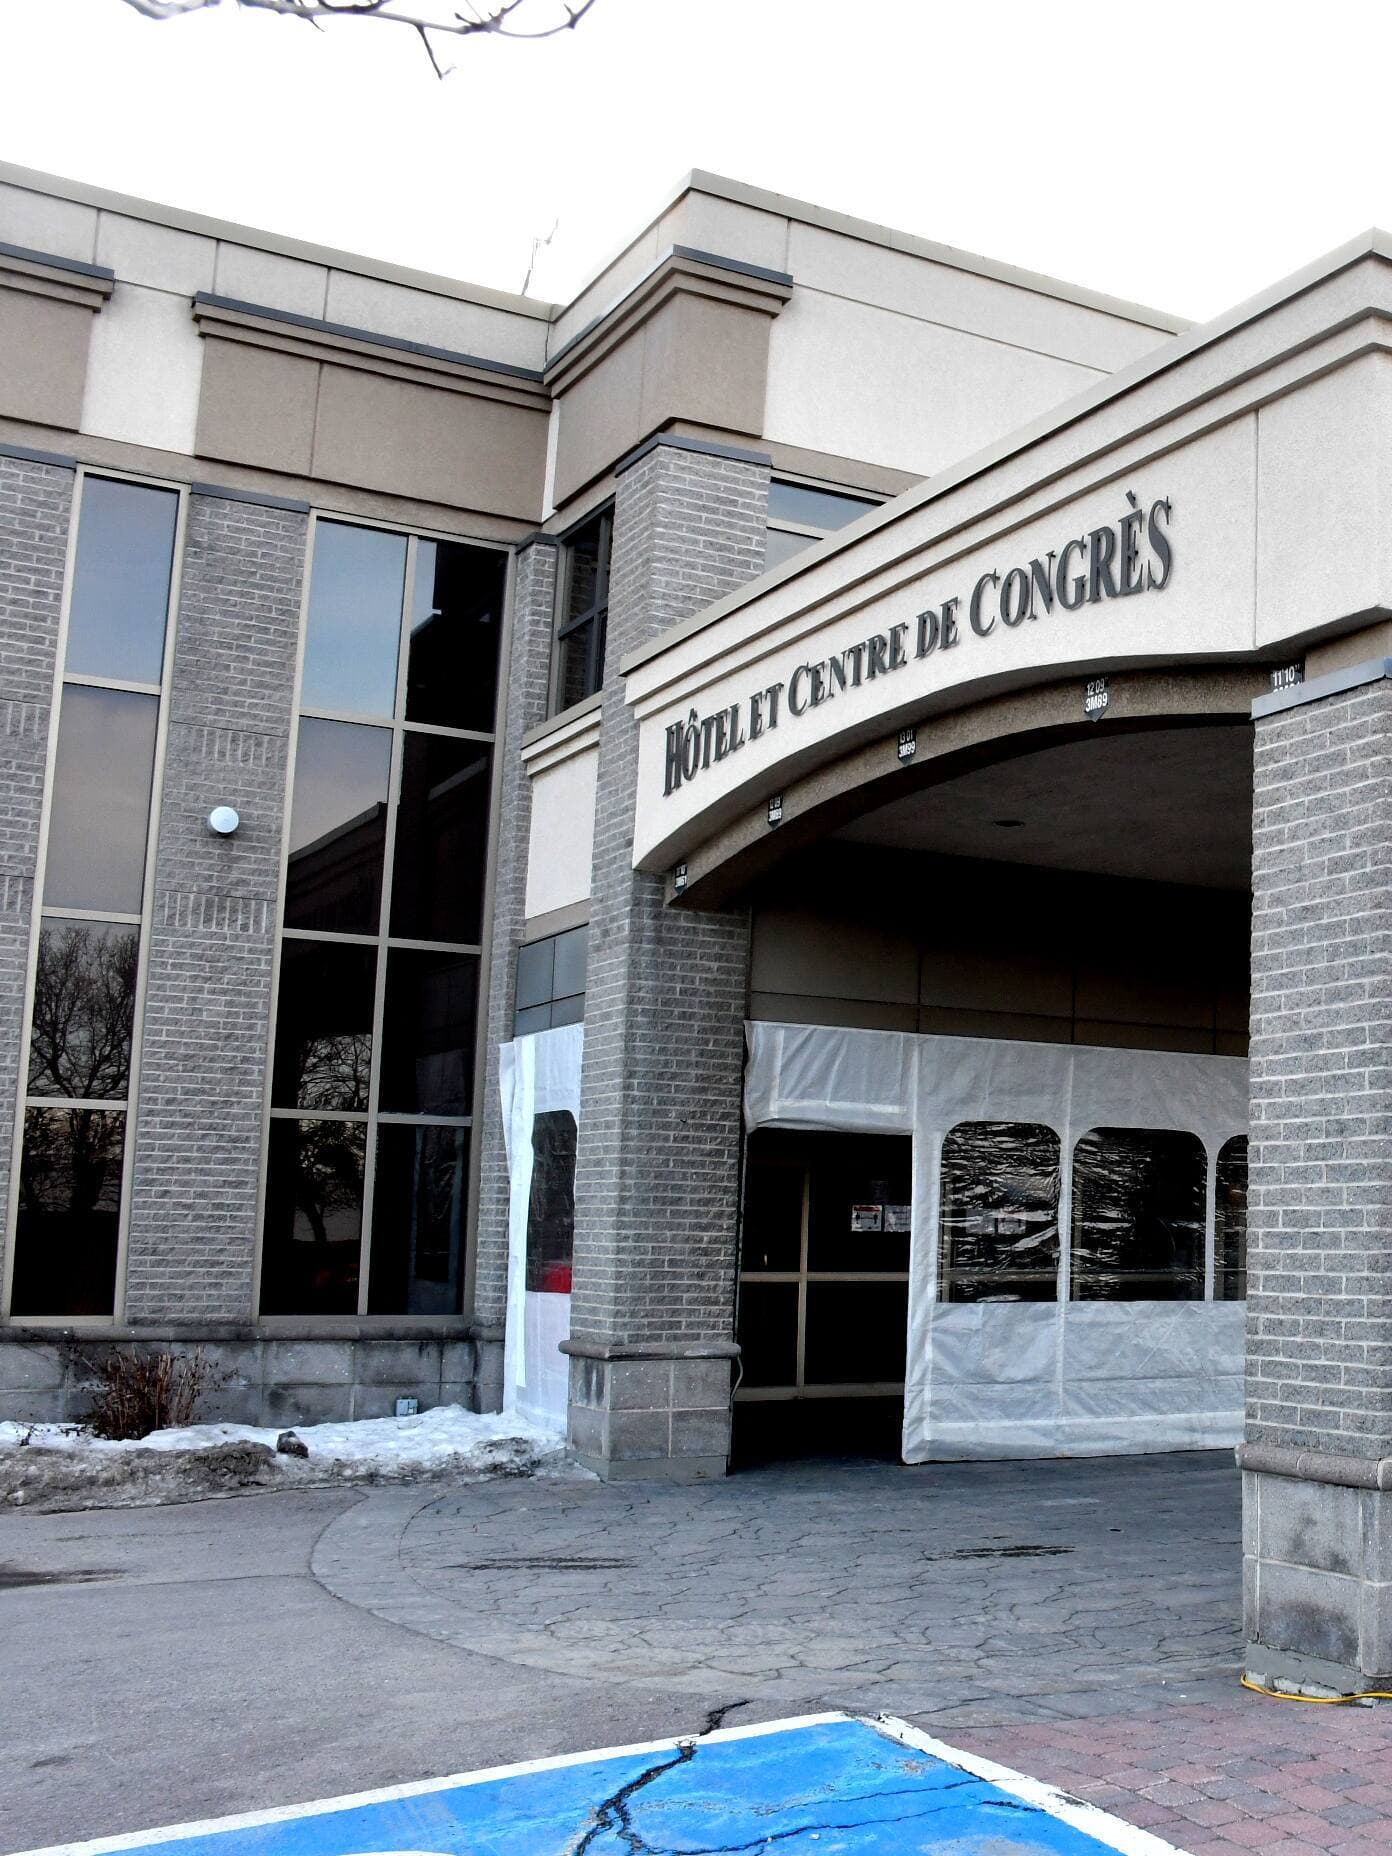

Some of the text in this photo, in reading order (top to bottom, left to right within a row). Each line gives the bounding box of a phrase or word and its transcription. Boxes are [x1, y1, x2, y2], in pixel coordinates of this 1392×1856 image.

[663, 490, 1172, 797] HÔTEL ET CENTRE DE CONGRÈS
